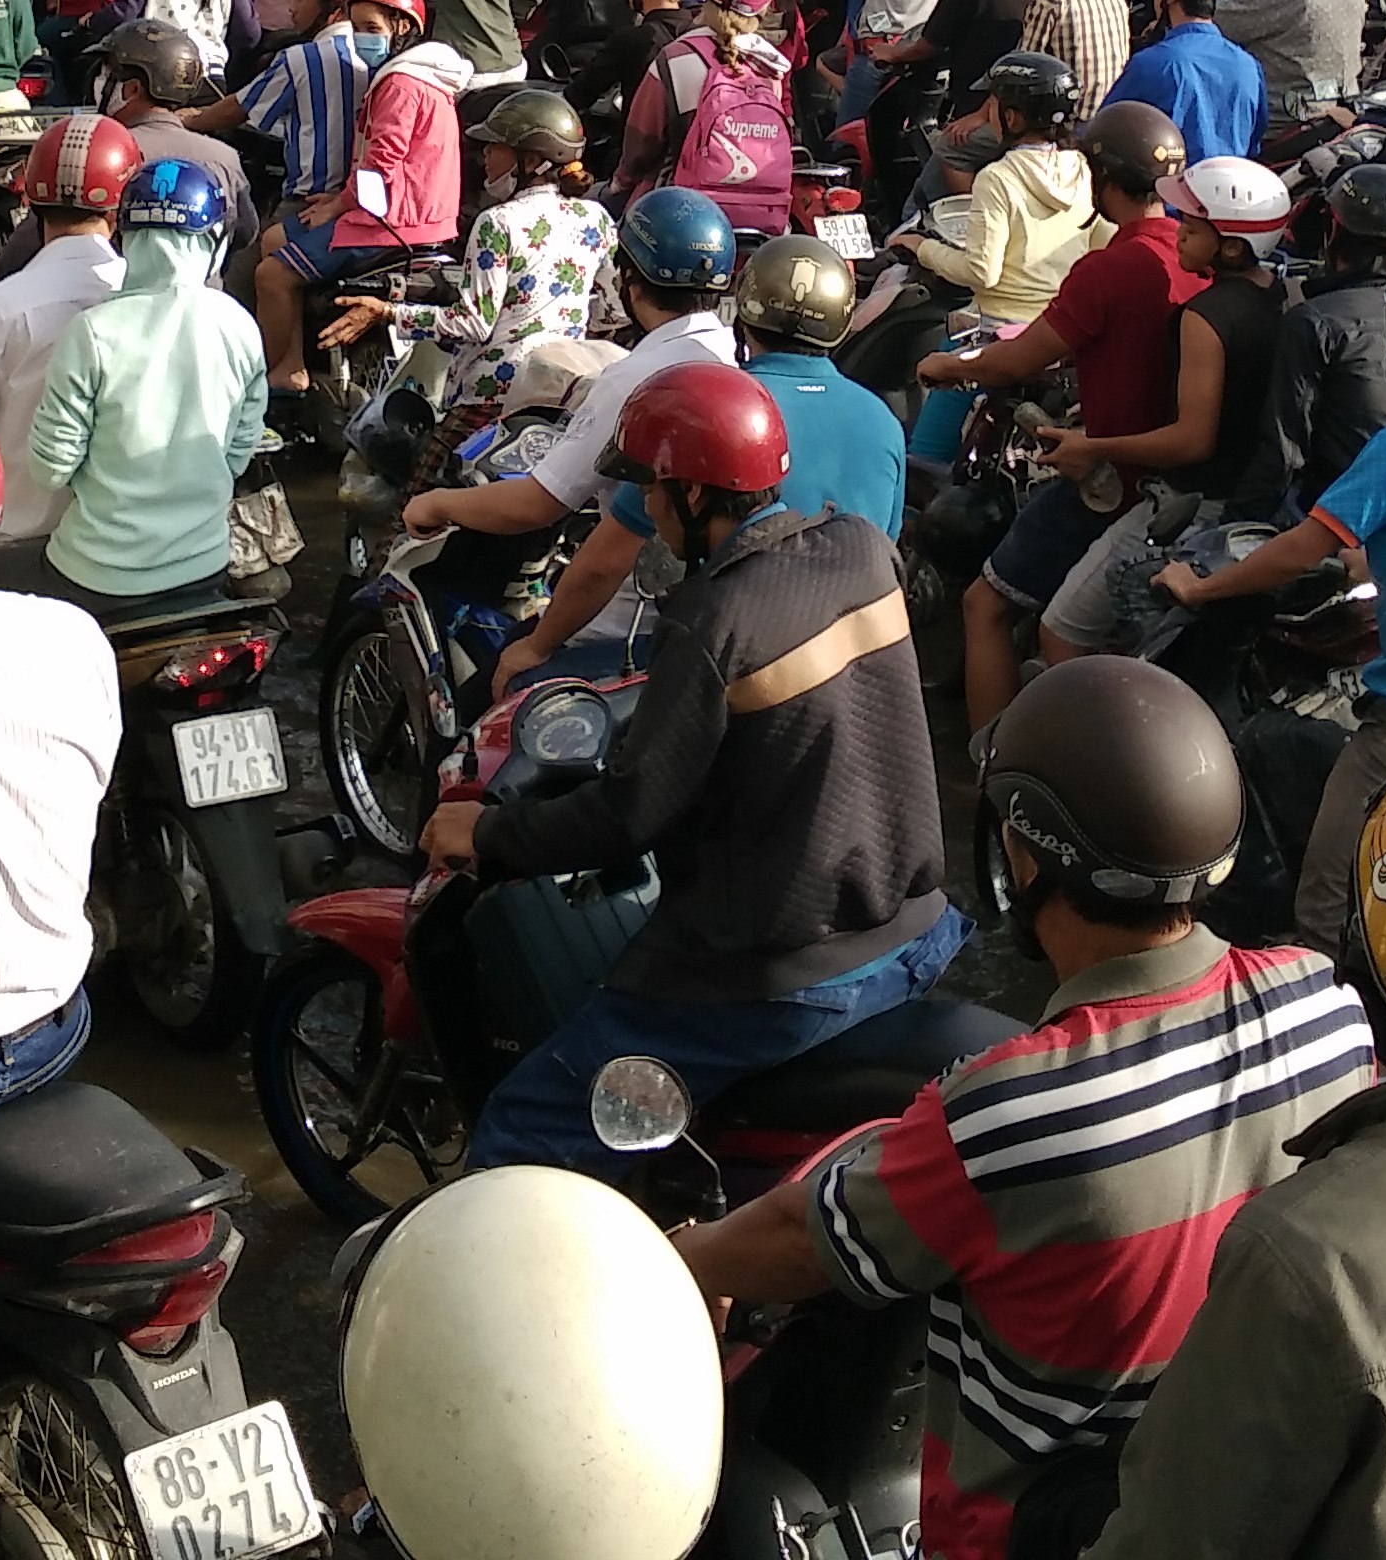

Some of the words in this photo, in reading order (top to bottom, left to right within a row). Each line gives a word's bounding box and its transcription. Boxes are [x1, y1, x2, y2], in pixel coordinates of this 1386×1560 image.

[723, 115, 779, 143] Supreme
[1009, 790, 1082, 866] Vespa
[152, 1367, 199, 1390] HONDA
